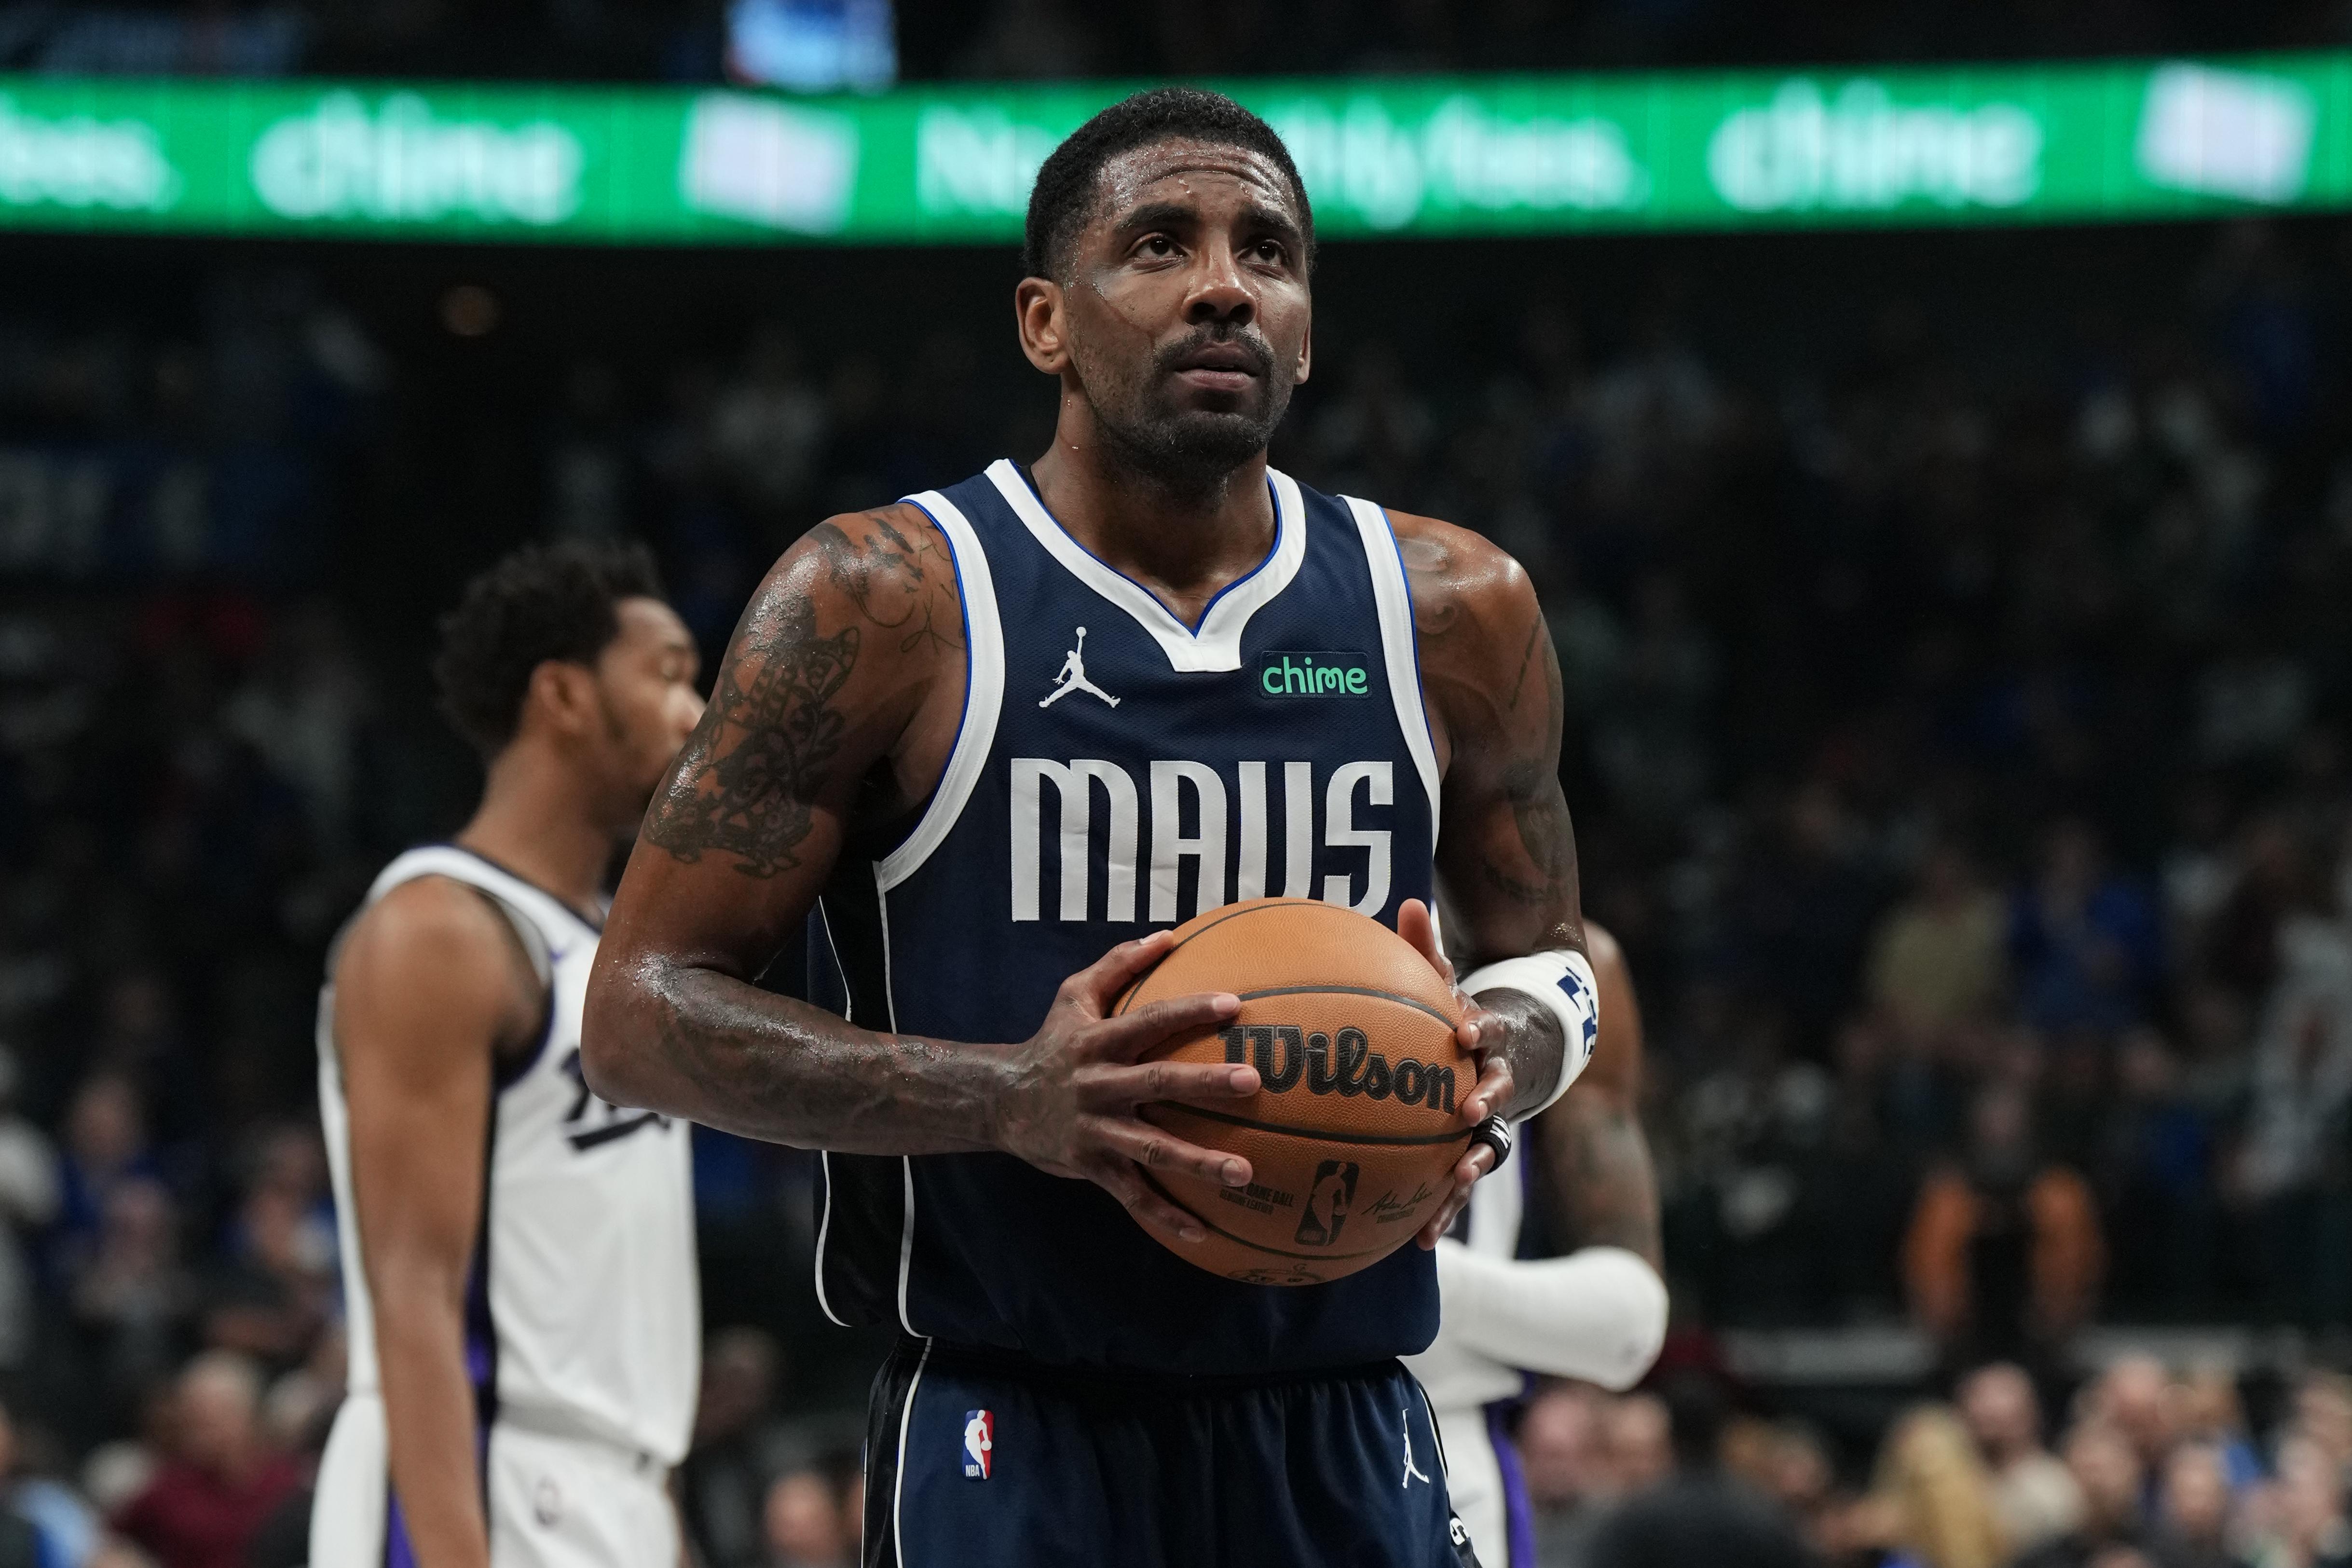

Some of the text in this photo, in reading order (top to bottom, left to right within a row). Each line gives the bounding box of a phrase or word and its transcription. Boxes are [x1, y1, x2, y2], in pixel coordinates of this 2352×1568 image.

[0, 112, 186, 212] ees.
[1263, 656, 1367, 694] chime
[1217, 1024, 1455, 1115] Wilson
[965, 1464, 980, 1477] NBA
